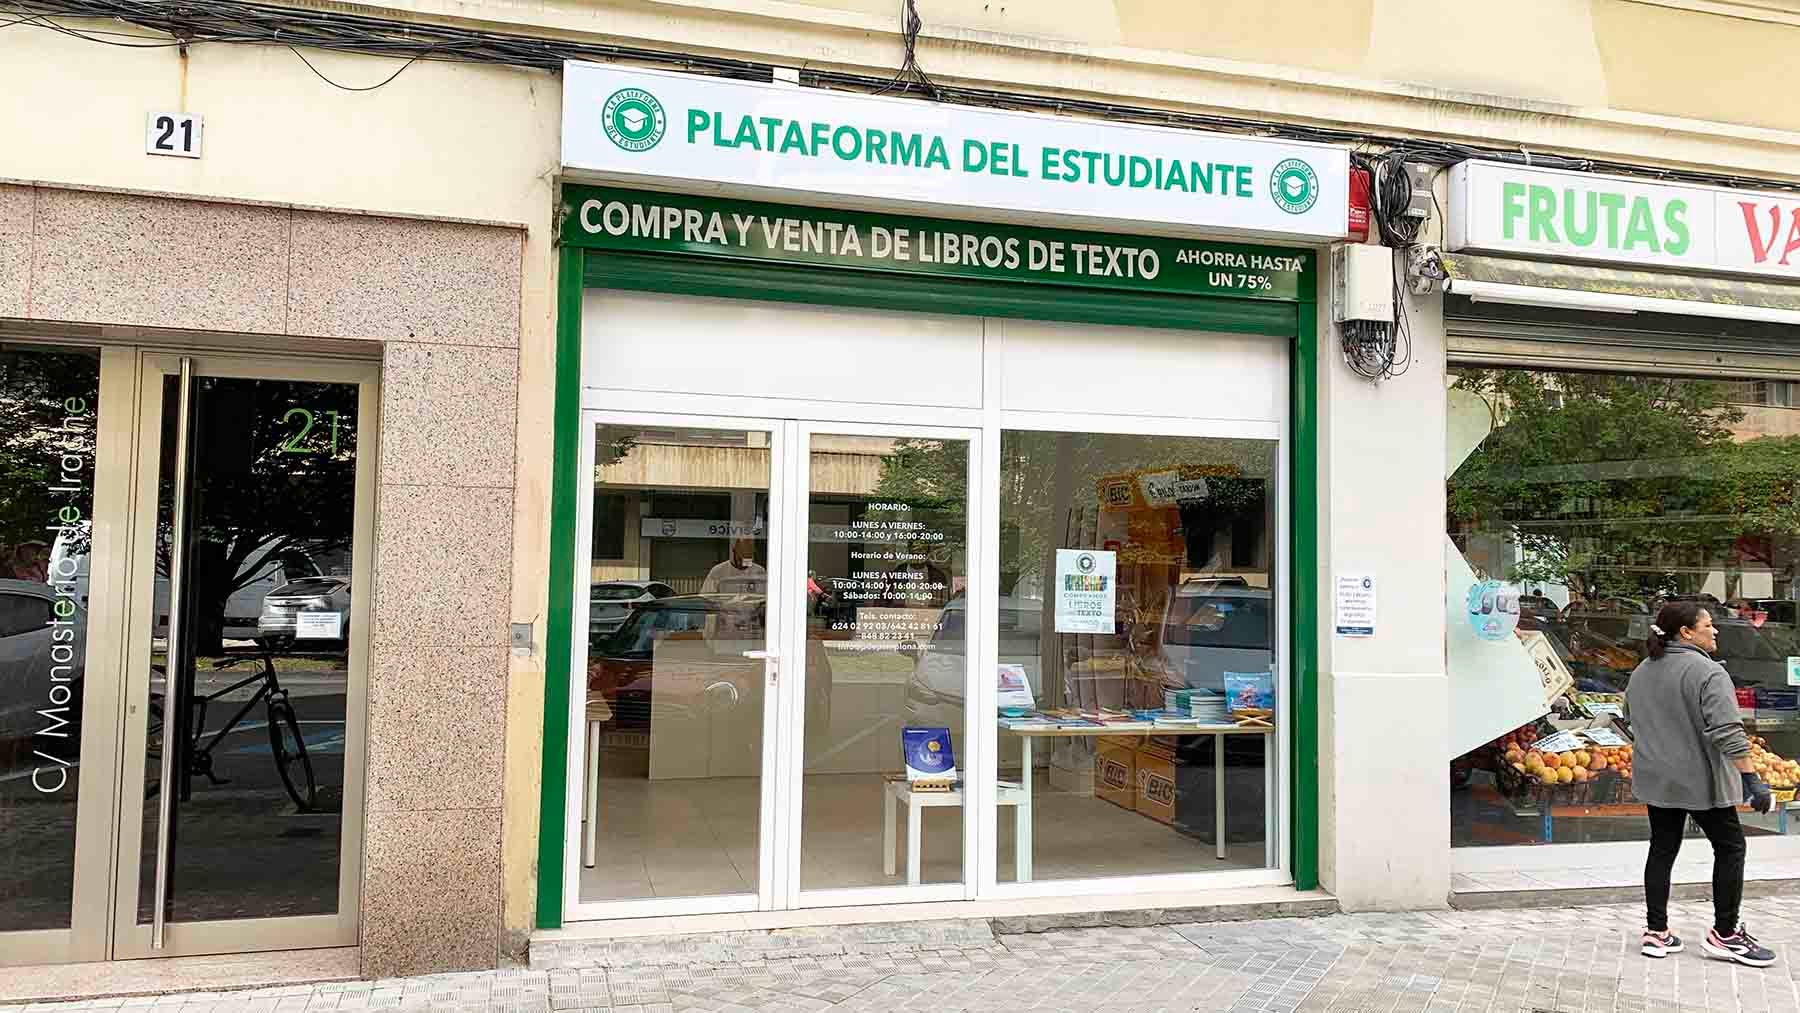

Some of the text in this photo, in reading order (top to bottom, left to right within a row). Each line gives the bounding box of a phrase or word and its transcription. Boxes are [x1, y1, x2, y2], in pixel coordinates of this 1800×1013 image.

[155, 115, 194, 153] 21
[687, 109, 1253, 198] PLATAFORMA DEL ESTUDIANTE
[1502, 182, 1691, 256] FRUTAS
[579, 199, 1160, 280] COMPRA Y VENTA DE LIBROS DE TEXTO
[1176, 248, 1303, 273] AHORRA HASTA
[1208, 272, 1273, 291] UN 75%
[280, 406, 339, 455] 21
[1110, 486, 1128, 502] BIC
[868, 503, 911, 512] HORARIO:
[852, 521, 880, 529] LUNES
[888, 521, 926, 530] VIERNES:
[833, 531, 885, 539] 10:00-14:00
[894, 532, 944, 540] 16:00-20:00
[851, 551, 926, 560] Horario de Verano:
[852, 571, 880, 579] LUNES
[888, 572, 924, 580] VIERNES
[833, 581, 885, 589] 10:00-14:00
[893, 582, 943, 590] 16:00-20:00
[32, 396, 86, 794] C/ Monasterio de Irache
[843, 591, 933, 600] Sábados: 10:00-14:00
[860, 612, 878, 620] Tels.
[1077, 609, 1102, 617] TEXTO
[831, 622, 848, 630] 624
[863, 623, 874, 631] 92
[1150, 778, 1173, 802] BIC
